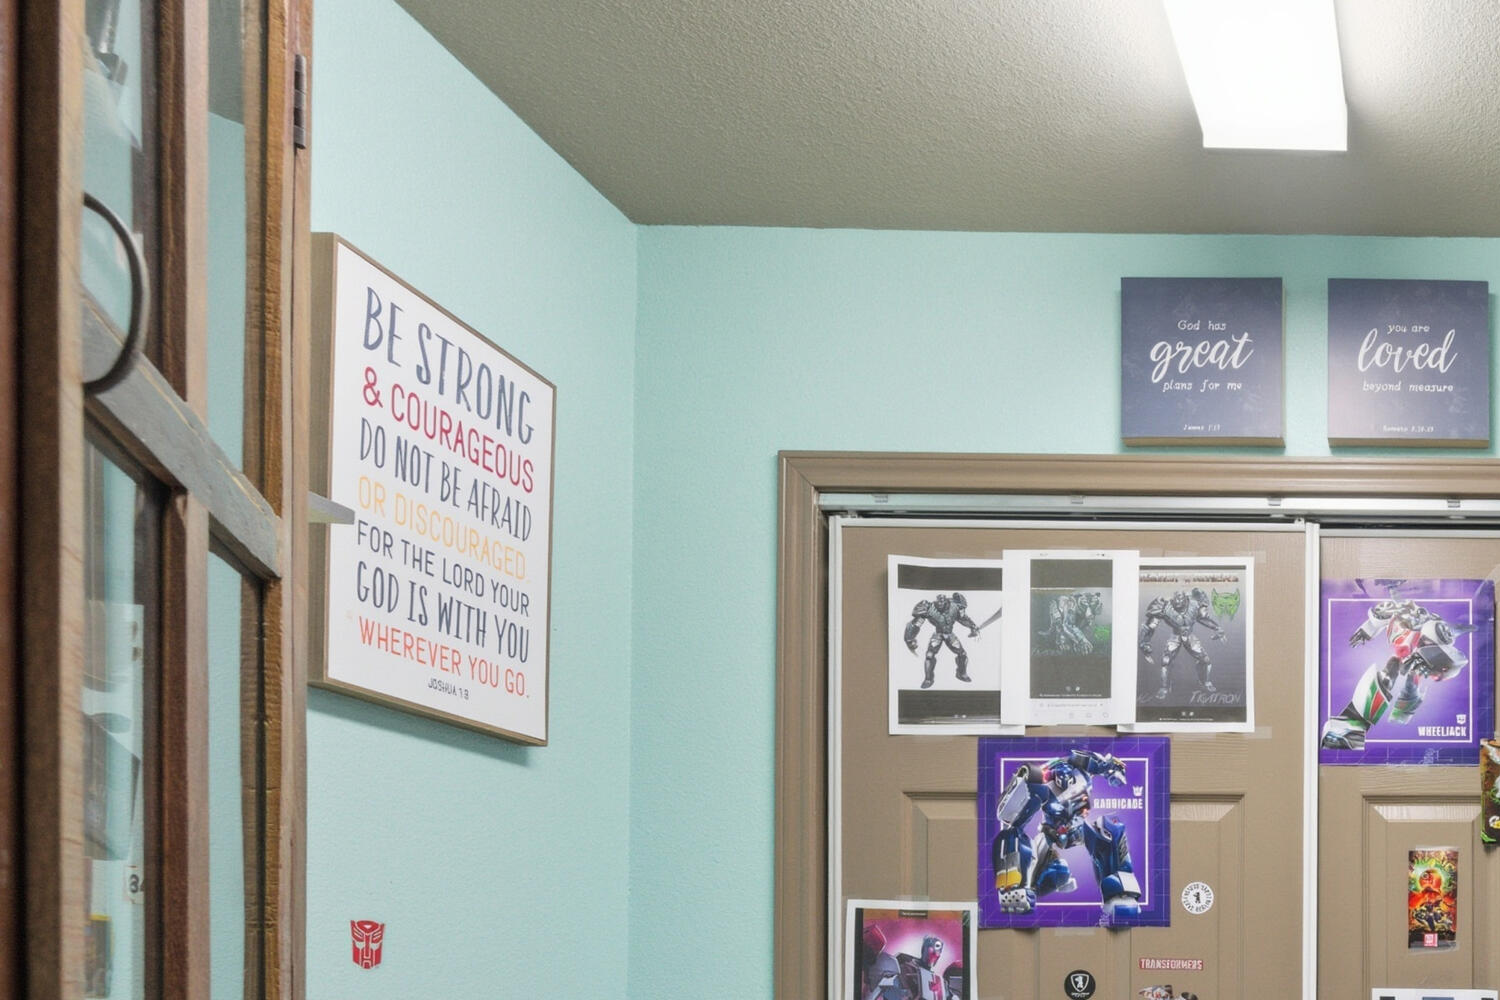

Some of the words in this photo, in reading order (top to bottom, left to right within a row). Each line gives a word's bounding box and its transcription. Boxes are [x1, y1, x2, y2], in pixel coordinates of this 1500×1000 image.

[1177, 319, 1201, 331] God
[1207, 319, 1228, 331] has
[1386, 324, 1408, 335] you
[1411, 325, 1431, 333] are
[363, 286, 404, 368] BE
[416, 322, 535, 445] STRONG
[1149, 331, 1255, 384] great
[1357, 327, 1459, 374] loved
[1162, 379, 1194, 393] plans
[1199, 379, 1221, 393] for
[1226, 382, 1243, 390] me
[1362, 380, 1402, 393] beyond
[1408, 384, 1455, 393] measure
[363, 366, 384, 408] &
[391, 383, 534, 494] COURAGEOUS
[359, 476, 387, 518] OR
[360, 417, 386, 470] DO
[395, 435, 435, 494] NOT
[440, 460, 461, 508] BE
[467, 478, 532, 542] AFRAID
[357, 519, 394, 560] FOR
[401, 539, 436, 578] THE
[442, 557, 485, 598] LORD
[491, 579, 530, 617] YOUR
[356, 560, 400, 613] GOD
[407, 580, 429, 627] IS
[438, 592, 488, 649] WITH
[494, 614, 530, 663] YOU
[359, 615, 462, 677] WHEREVER
[468, 654, 500, 688] YOU
[428, 678, 458, 697] JOSHUA
[1416, 725, 1467, 738] WHEELJACK
[1139, 957, 1204, 971] TRANSFORMERS
